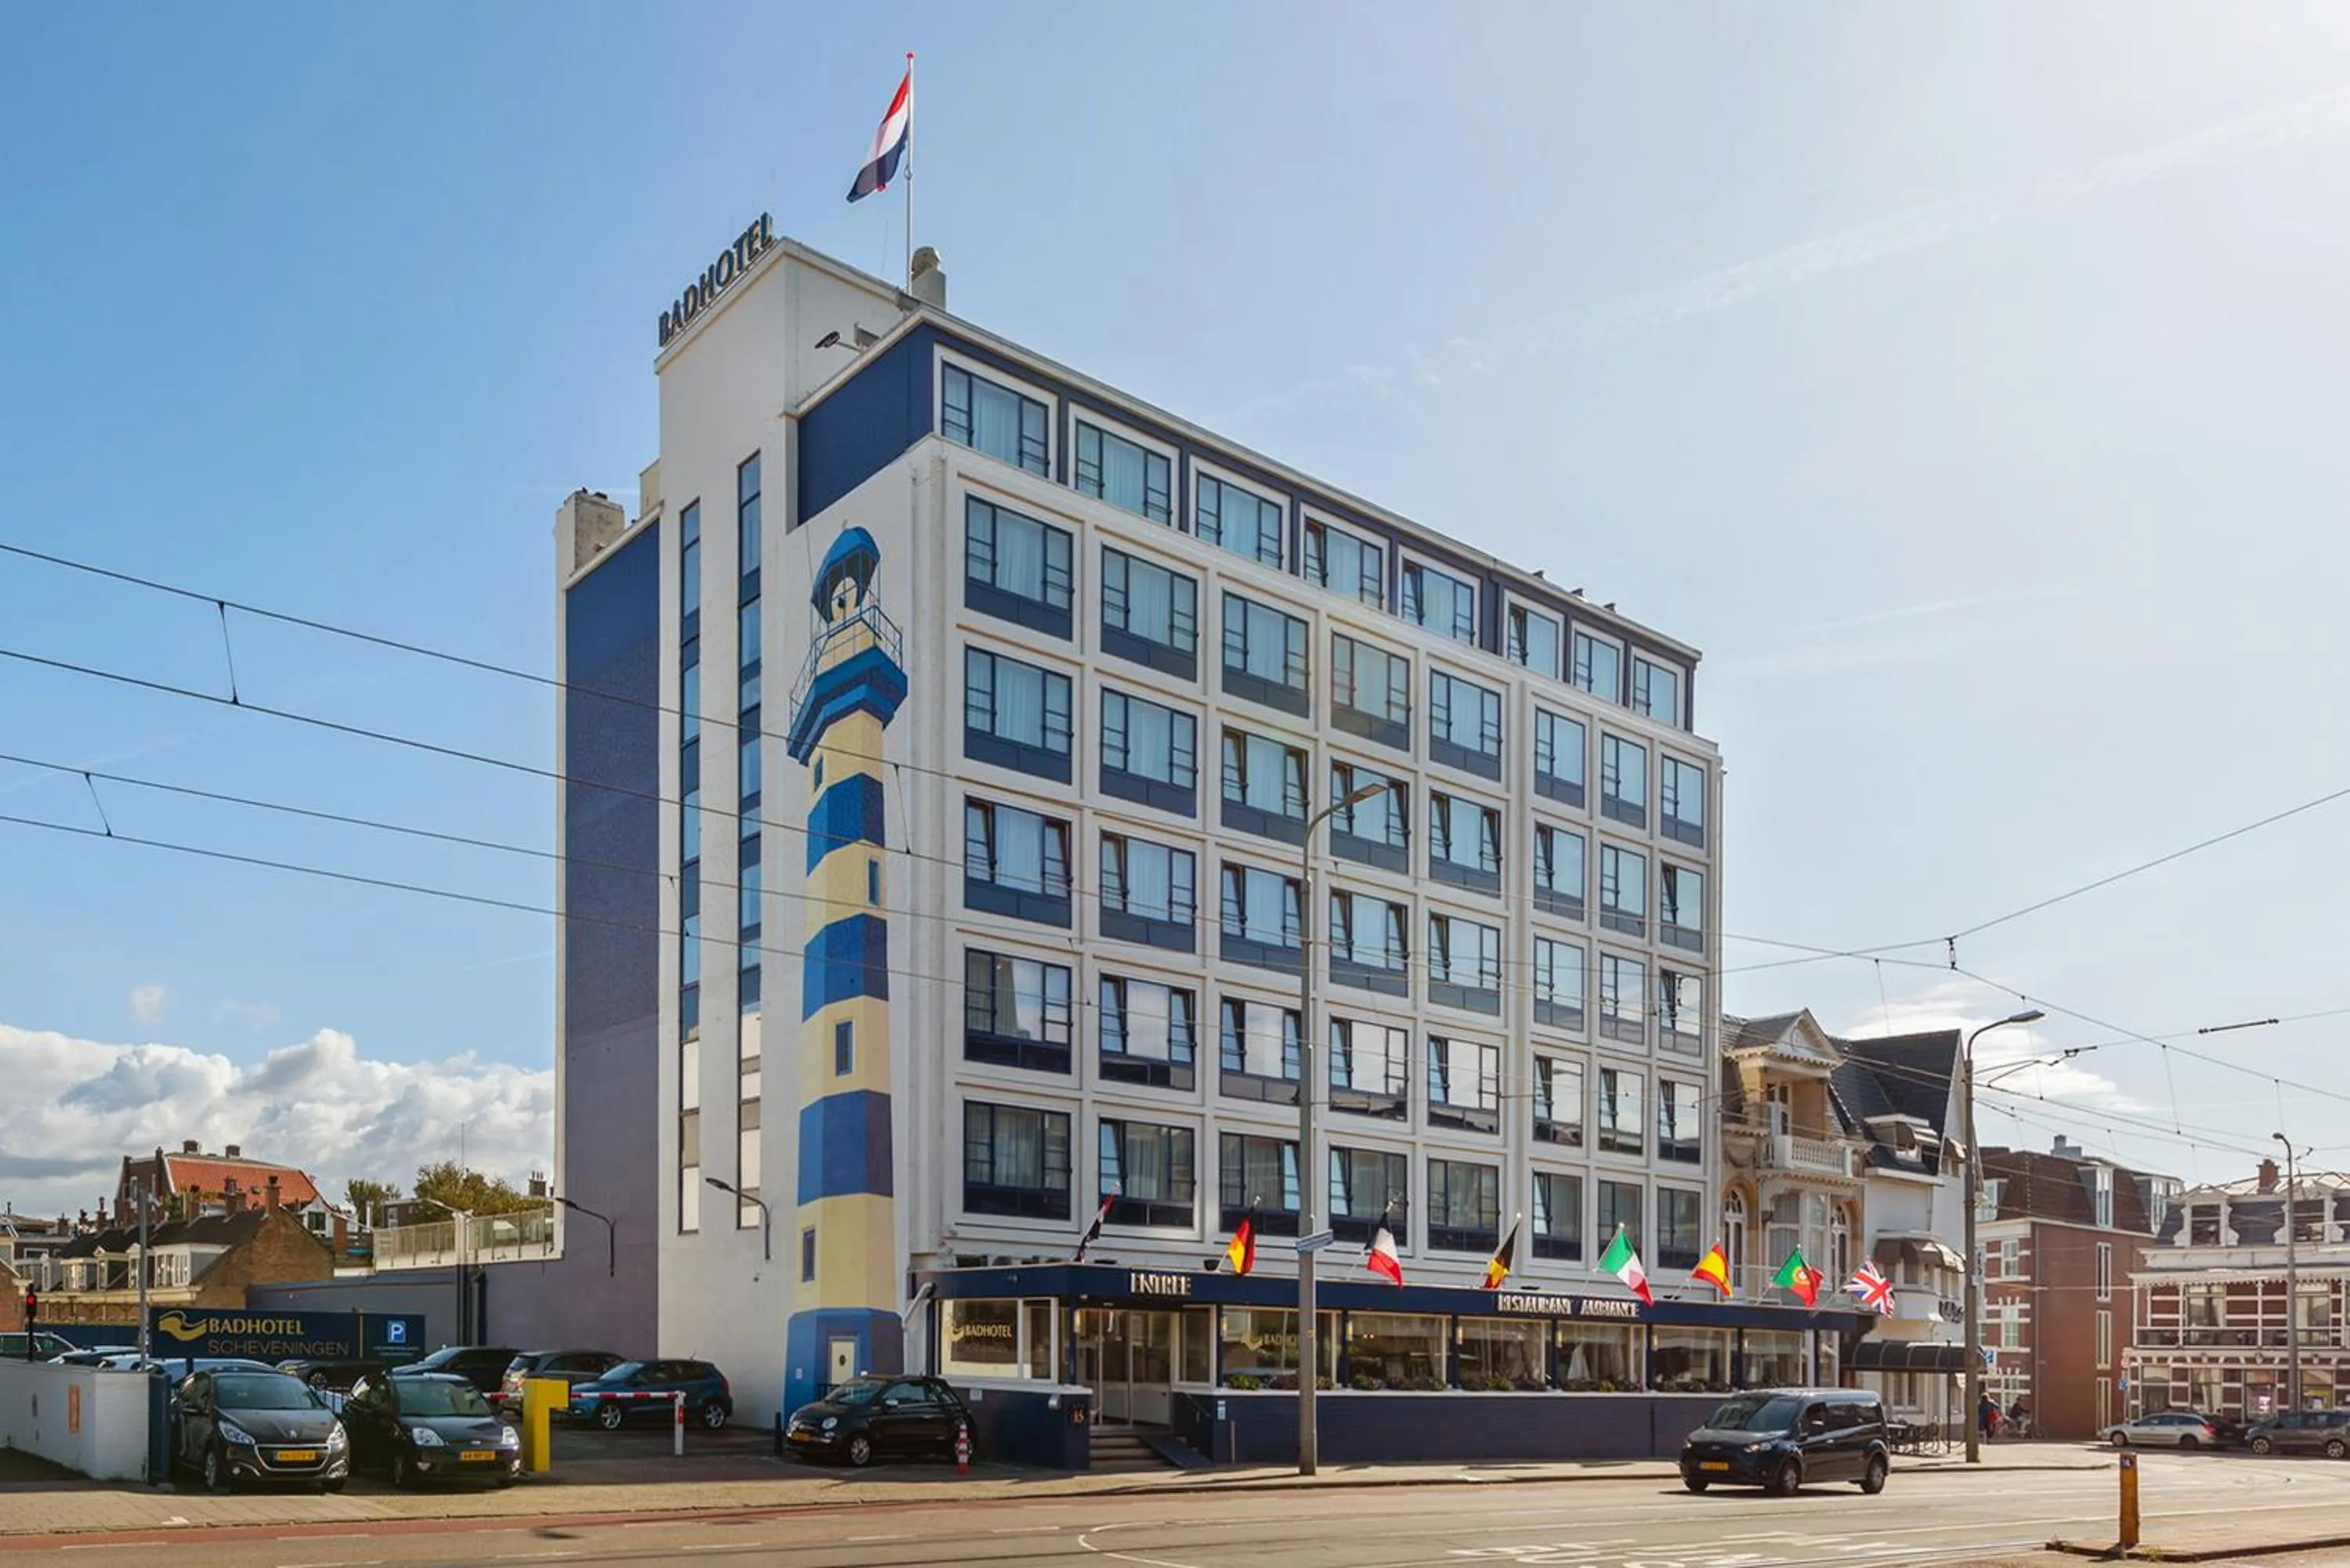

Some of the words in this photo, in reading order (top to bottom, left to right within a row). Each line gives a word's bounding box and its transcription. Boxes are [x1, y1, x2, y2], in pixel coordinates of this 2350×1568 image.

[658, 211, 774, 348] BADHOTEL
[1498, 1293, 1571, 1315] RESTAURANT
[208, 1318, 305, 1335] BADHOTEL
[965, 1324, 1013, 1339] BADHOTEL
[207, 1339, 349, 1355] SCHEVENINGEN
